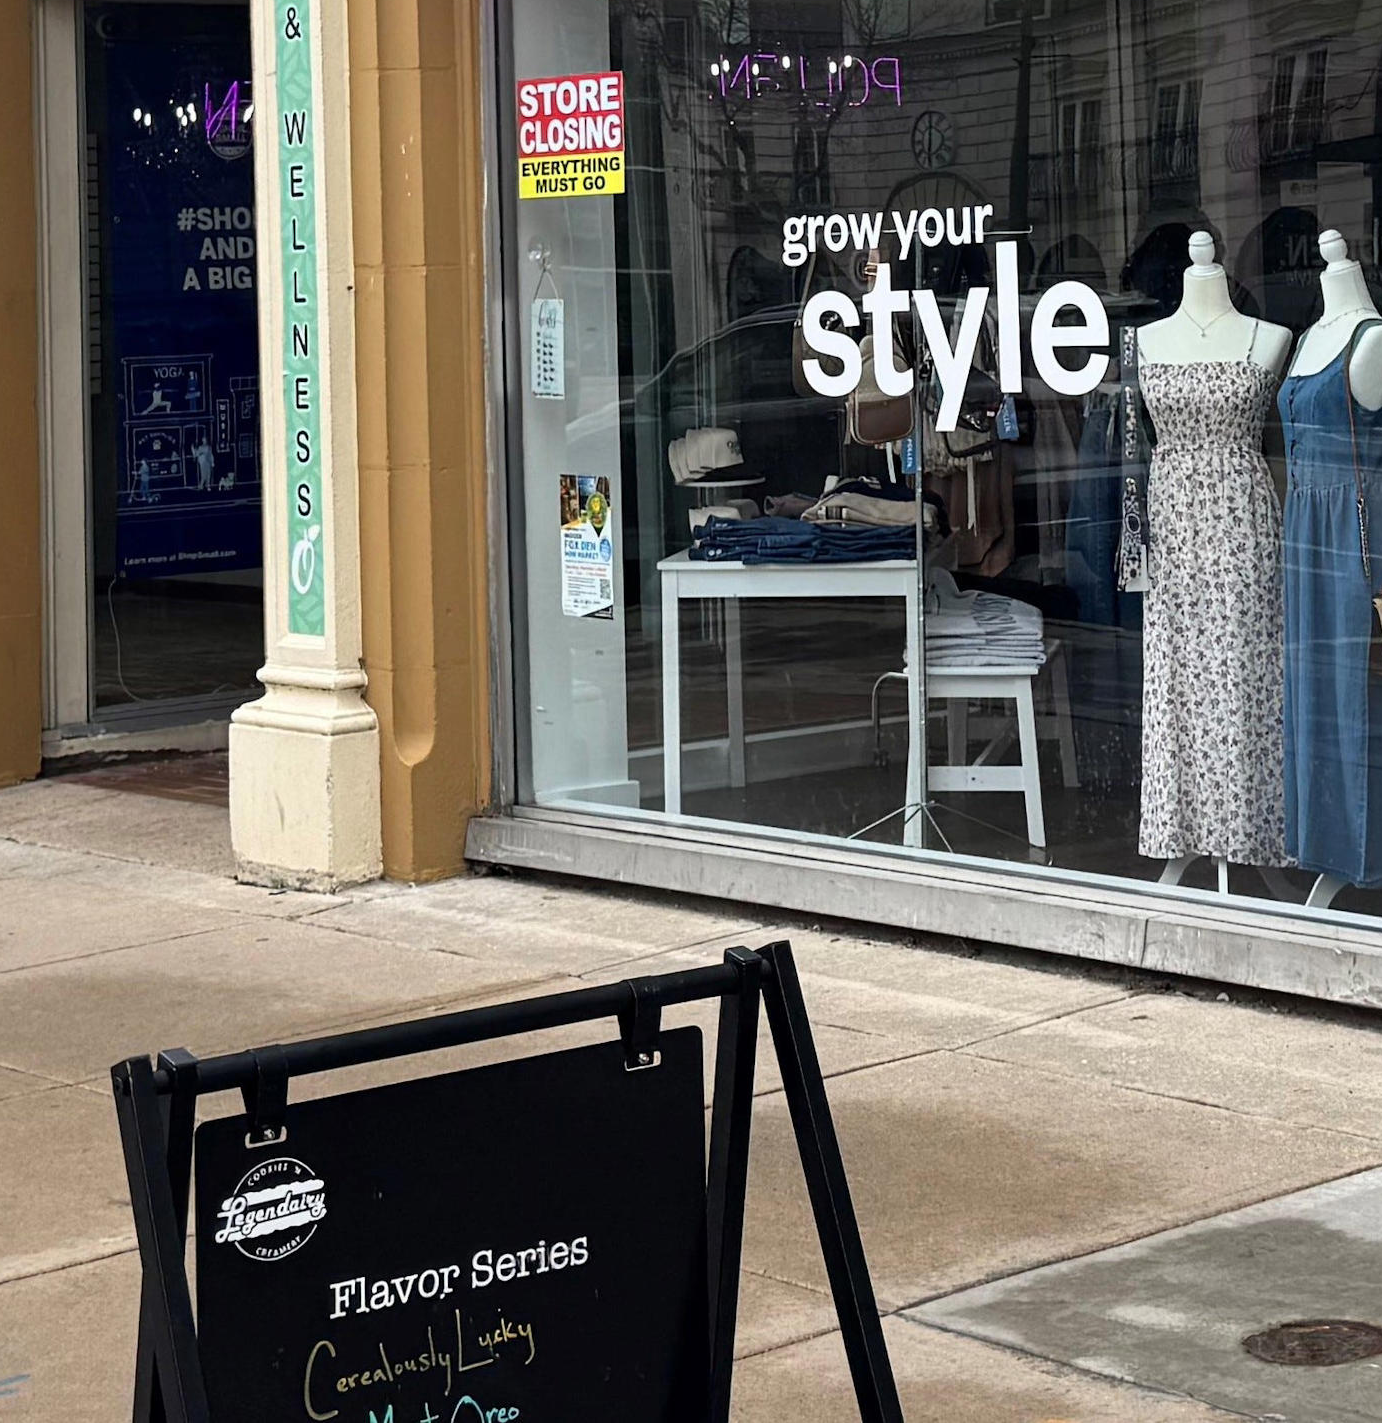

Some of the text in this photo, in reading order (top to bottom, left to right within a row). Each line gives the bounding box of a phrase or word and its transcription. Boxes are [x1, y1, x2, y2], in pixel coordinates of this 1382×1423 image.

[284, 7, 302, 40] &
[519, 77, 620, 117] STORE
[519, 115, 621, 154] CLOSING
[521, 157, 620, 177] EVERYTHING
[535, 176, 606, 193] MUST GO
[199, 236, 254, 261] AND
[782, 203, 994, 267] grow your
[182, 266, 253, 291] A BIG
[284, 111, 313, 517] WELLNESS
[801, 240, 1110, 433] style
[329, 1236, 589, 1320] Flavor Series
